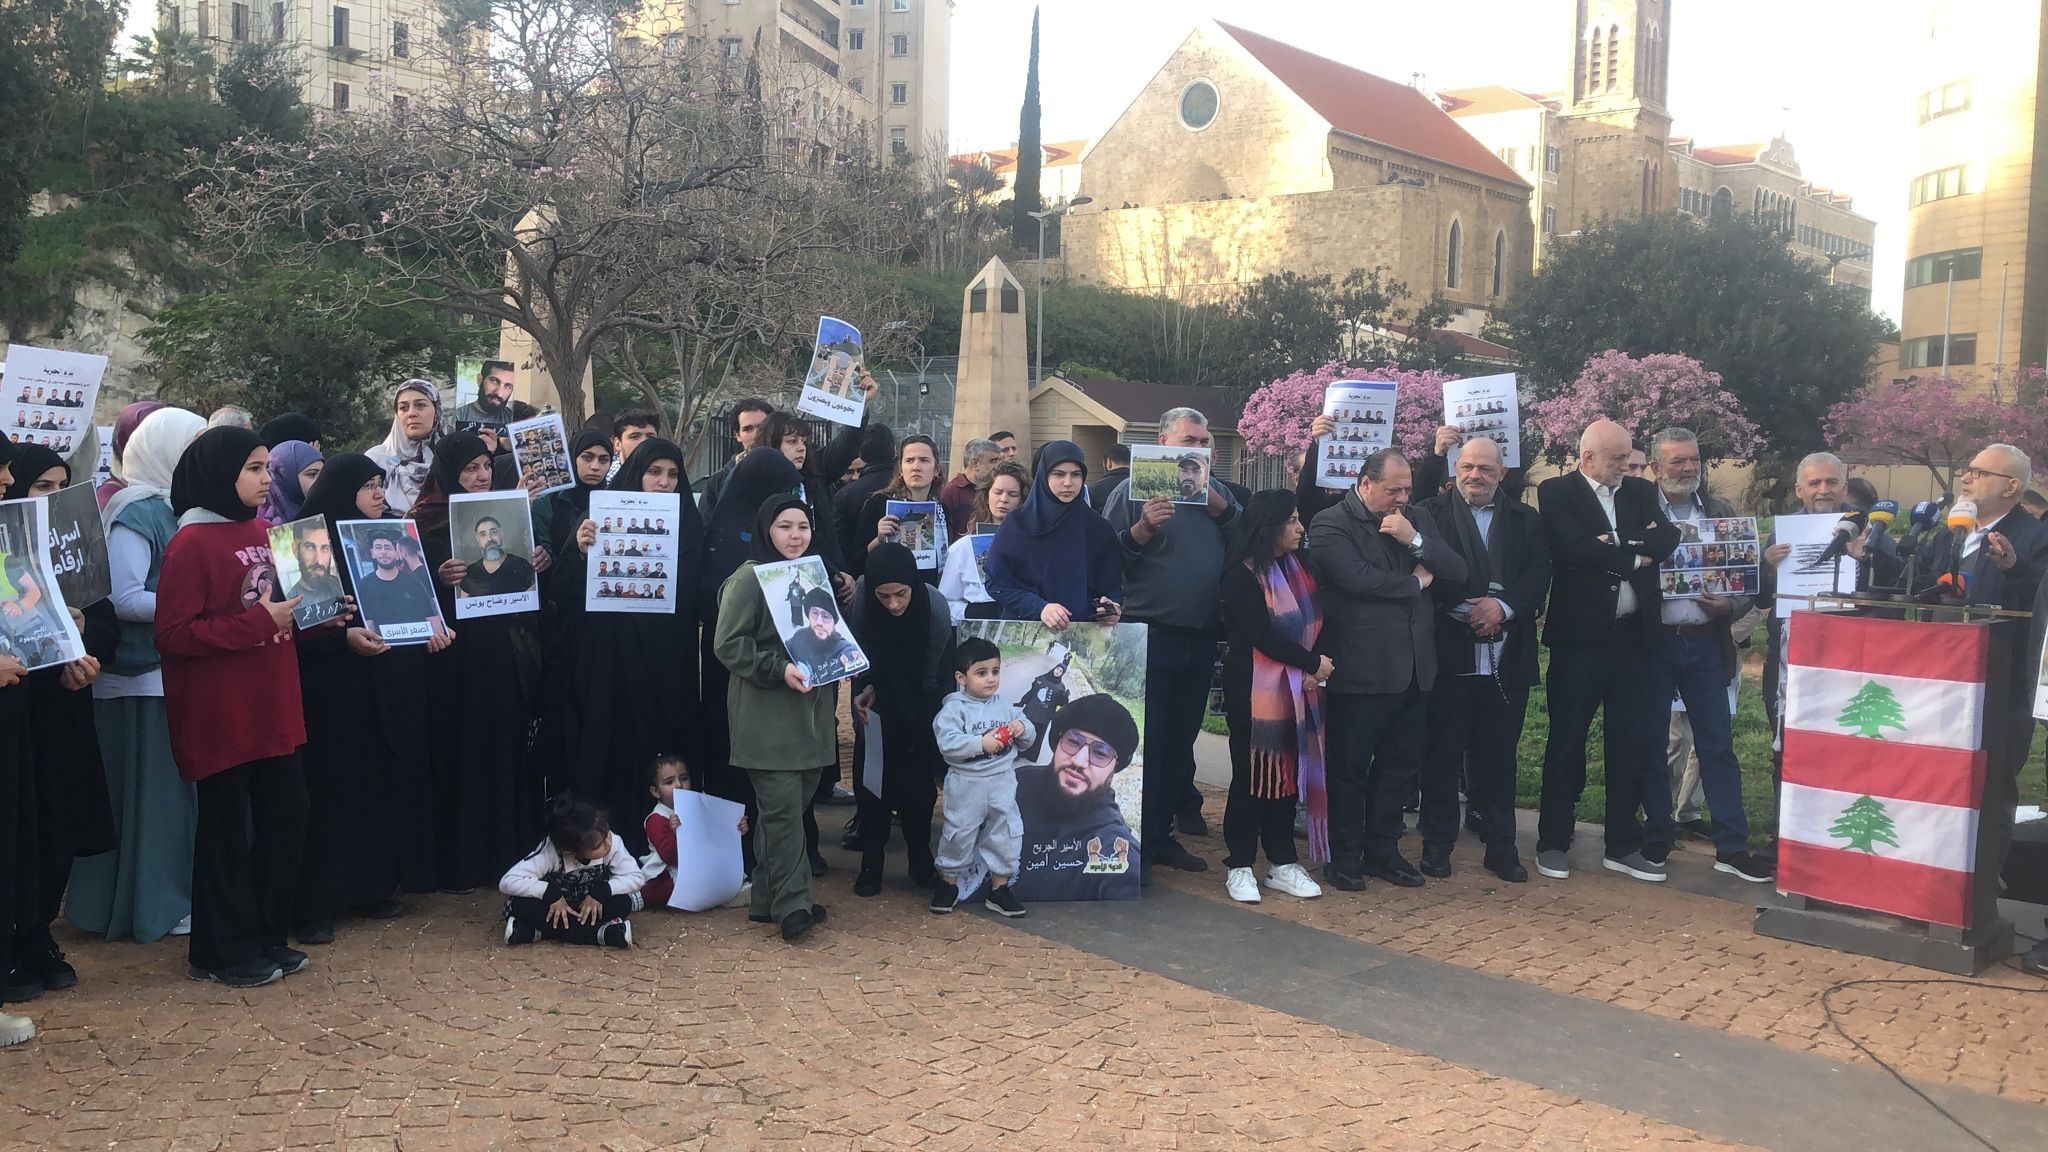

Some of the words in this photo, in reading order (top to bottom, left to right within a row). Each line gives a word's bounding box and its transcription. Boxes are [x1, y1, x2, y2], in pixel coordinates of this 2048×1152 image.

[1033, 839, 1058, 855] الجريح
[1060, 838, 1082, 853] الأسير
[1026, 853, 1049, 870] أمين
[1053, 860, 1084, 870] حسين
